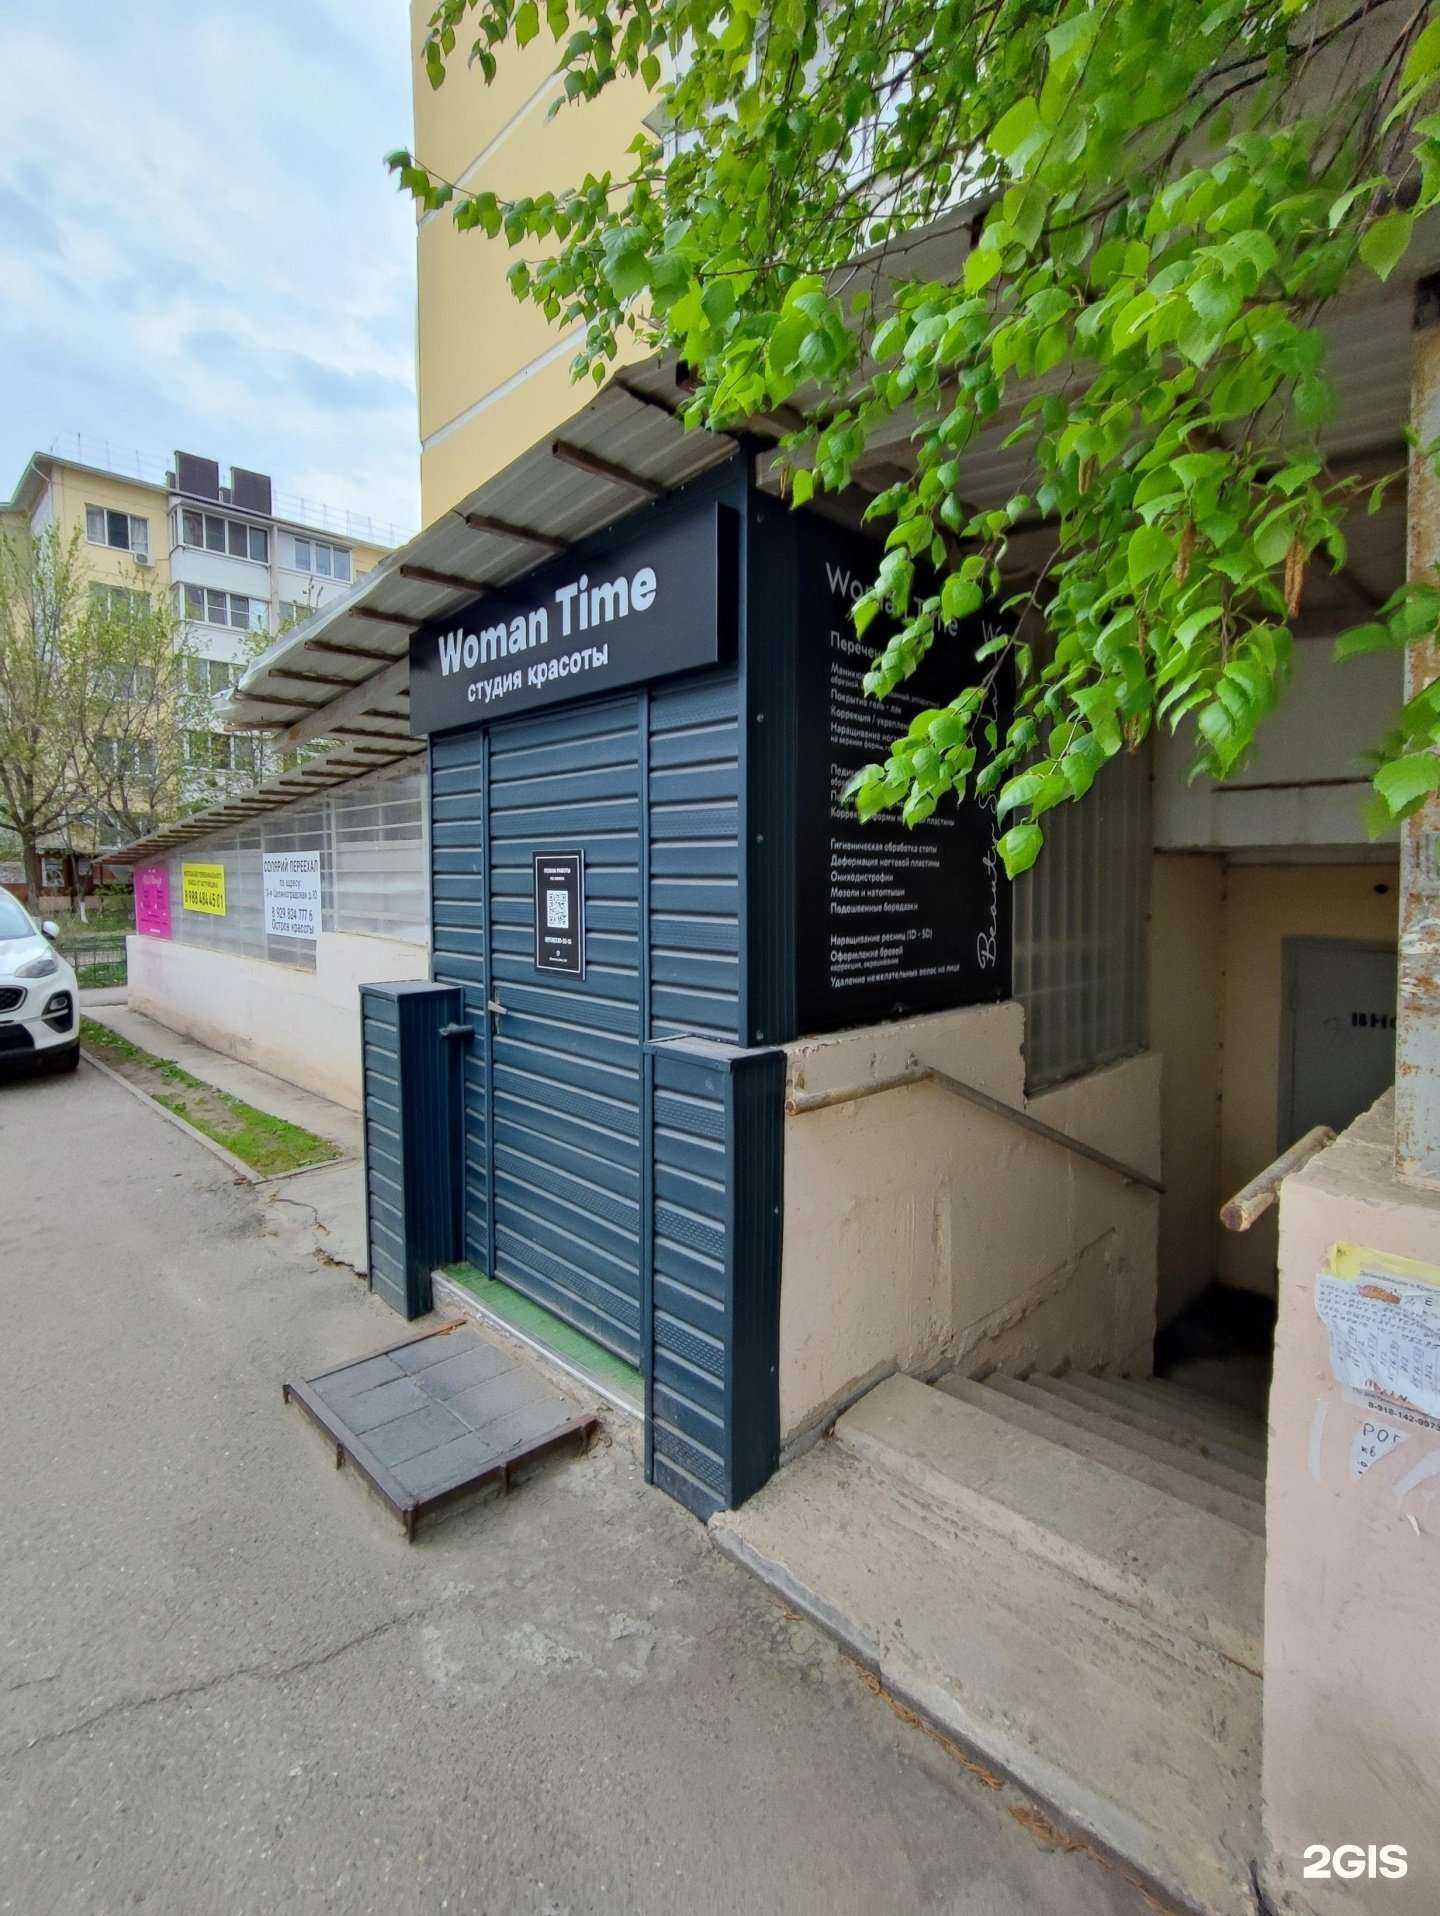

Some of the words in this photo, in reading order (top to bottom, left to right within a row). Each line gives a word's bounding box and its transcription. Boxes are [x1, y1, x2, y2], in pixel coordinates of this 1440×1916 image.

[438, 606, 549, 677] Woman
[554, 566, 657, 637] Time
[467, 669, 522, 704] студия
[527, 642, 609, 689] красоты
[830, 886, 860, 899] Мозоли
